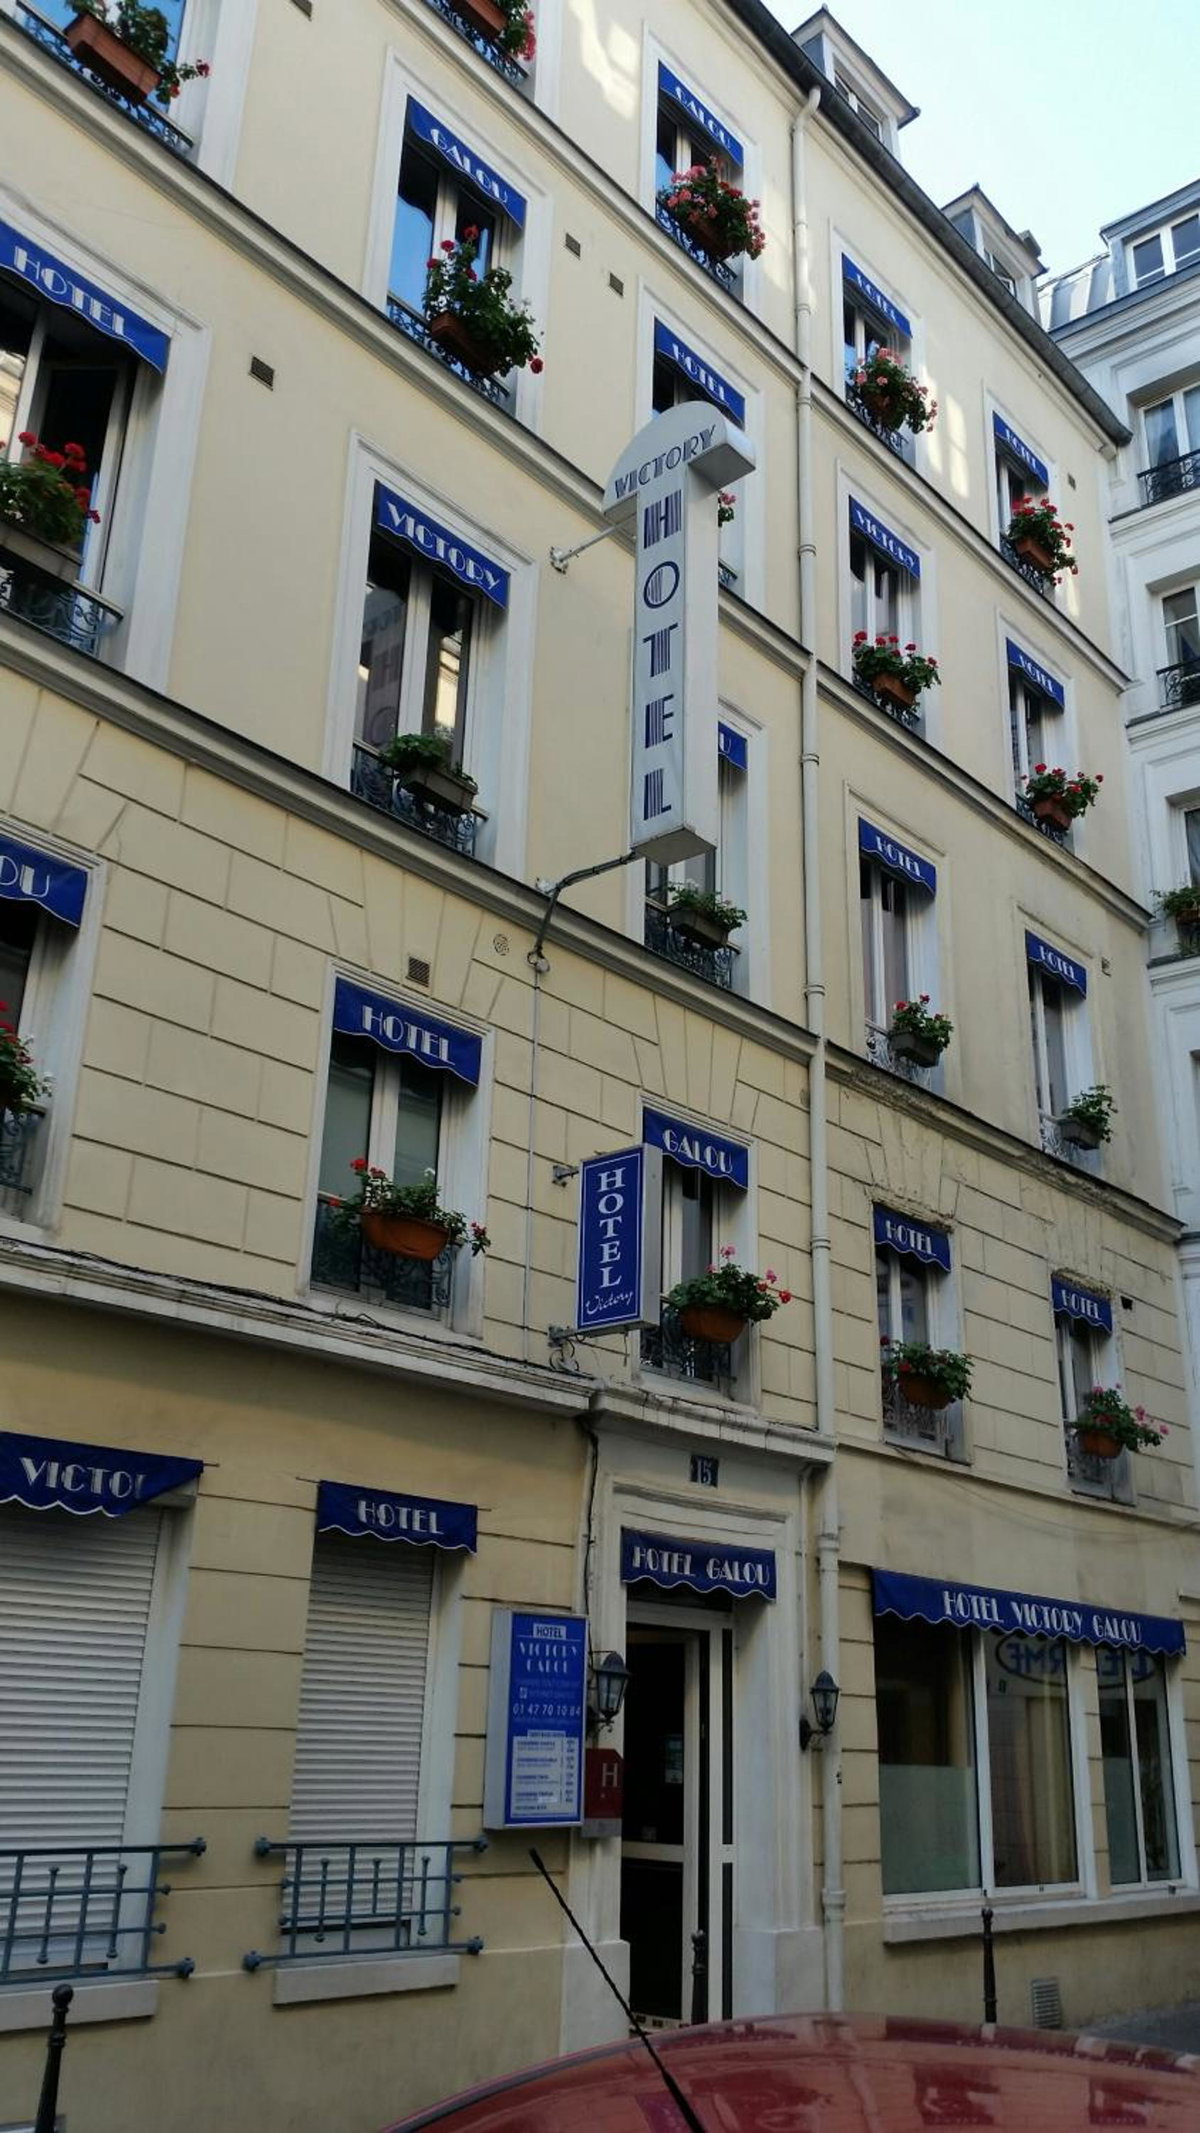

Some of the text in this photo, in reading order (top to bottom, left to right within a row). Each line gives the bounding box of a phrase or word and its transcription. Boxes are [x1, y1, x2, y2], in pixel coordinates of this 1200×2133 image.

[431, 129, 508, 203] GALOU
[14, 245, 134, 343] HOTEL
[856, 273, 900, 323] HOTEL
[672, 343, 729, 406] HOTEL
[615, 424, 716, 489] VICTORY
[388, 503, 500, 588] VICTORY
[855, 509, 916, 569] VICTORY
[643, 489, 681, 821] HOTEL
[1019, 653, 1057, 697] HOTEL
[876, 834, 925, 881] HOTEL
[1040, 945, 1078, 983] HOTEL
[362, 1004, 455, 1066] HOTEL
[662, 1129, 732, 1174] GALOU
[597, 1167, 626, 1289] HOTEL
[885, 1220, 937, 1257] HOTEL
[585, 1291, 633, 1315] Victory
[1061, 1288, 1103, 1321] HOTEL
[697, 1458, 711, 1484] 15
[357, 1500, 445, 1535] HOTEL
[632, 1545, 771, 1585] HOTEL GALOU
[536, 1626, 563, 1638] HOTEL
[943, 1590, 1142, 1644] HOTEL VICTORY GALOU
[602, 1763, 618, 1788] H
